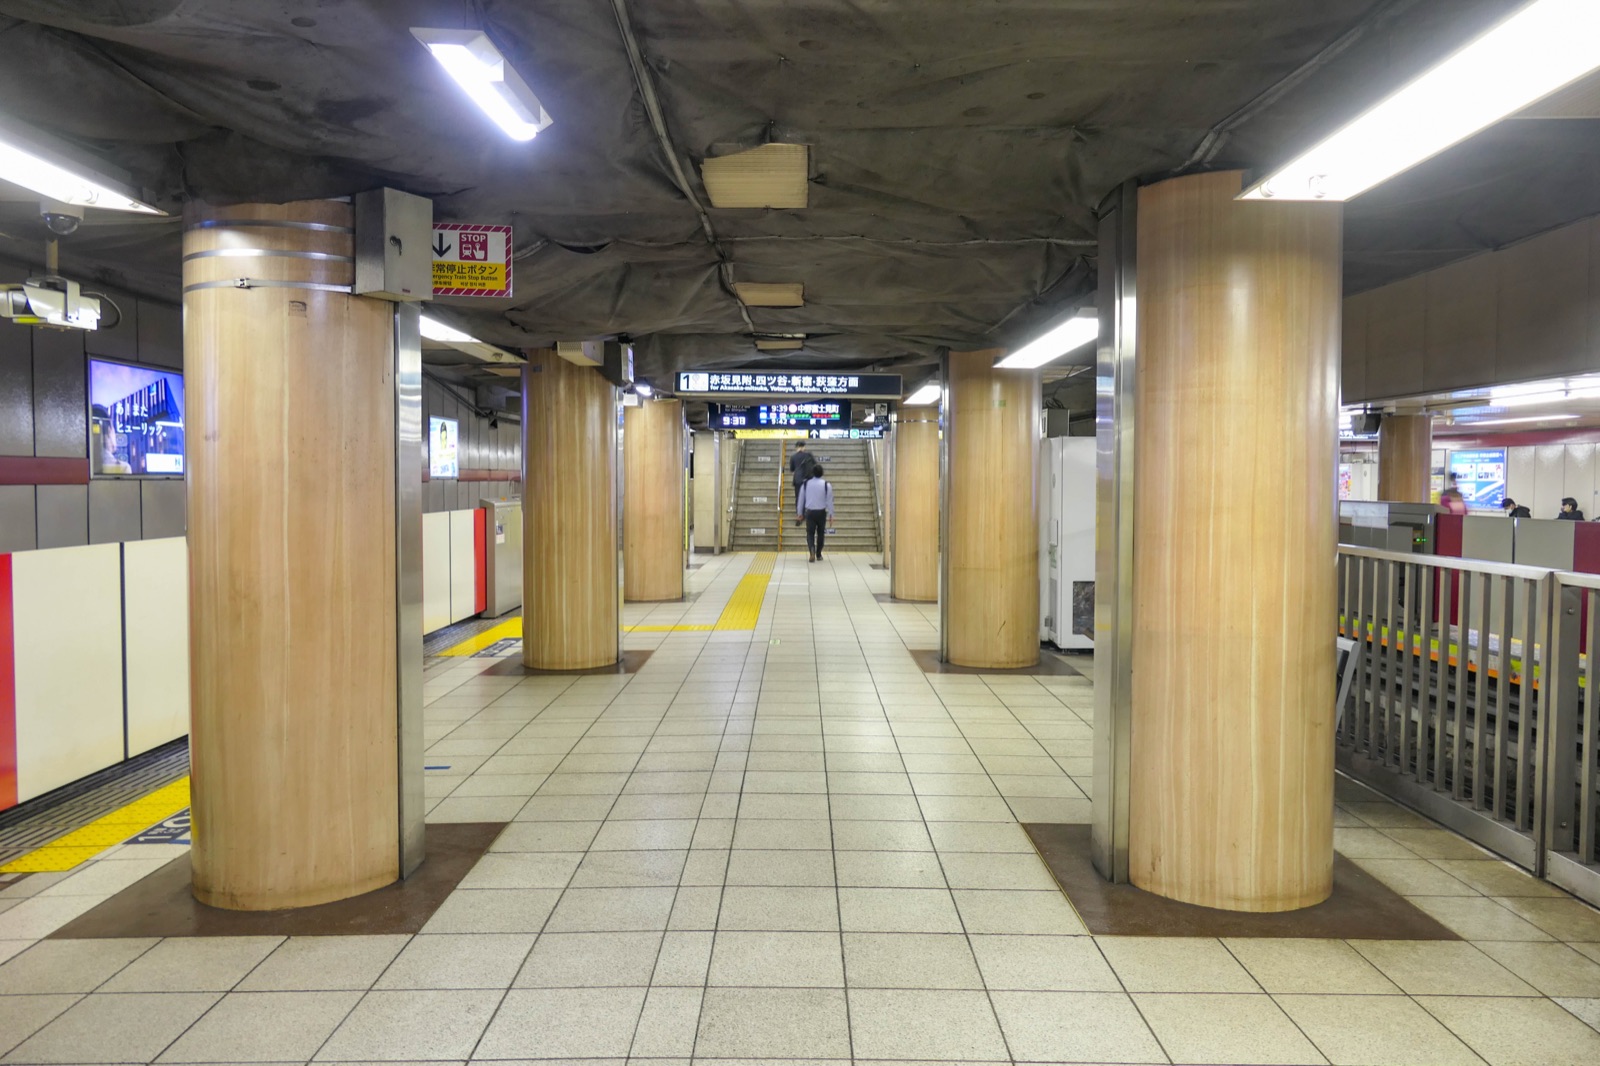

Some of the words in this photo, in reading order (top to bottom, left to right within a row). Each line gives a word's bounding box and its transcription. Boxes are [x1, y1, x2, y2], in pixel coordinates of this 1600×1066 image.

[461, 234, 486, 242] STOP
[683, 374, 690, 390] 1
[771, 404, 788, 412] 9:39
